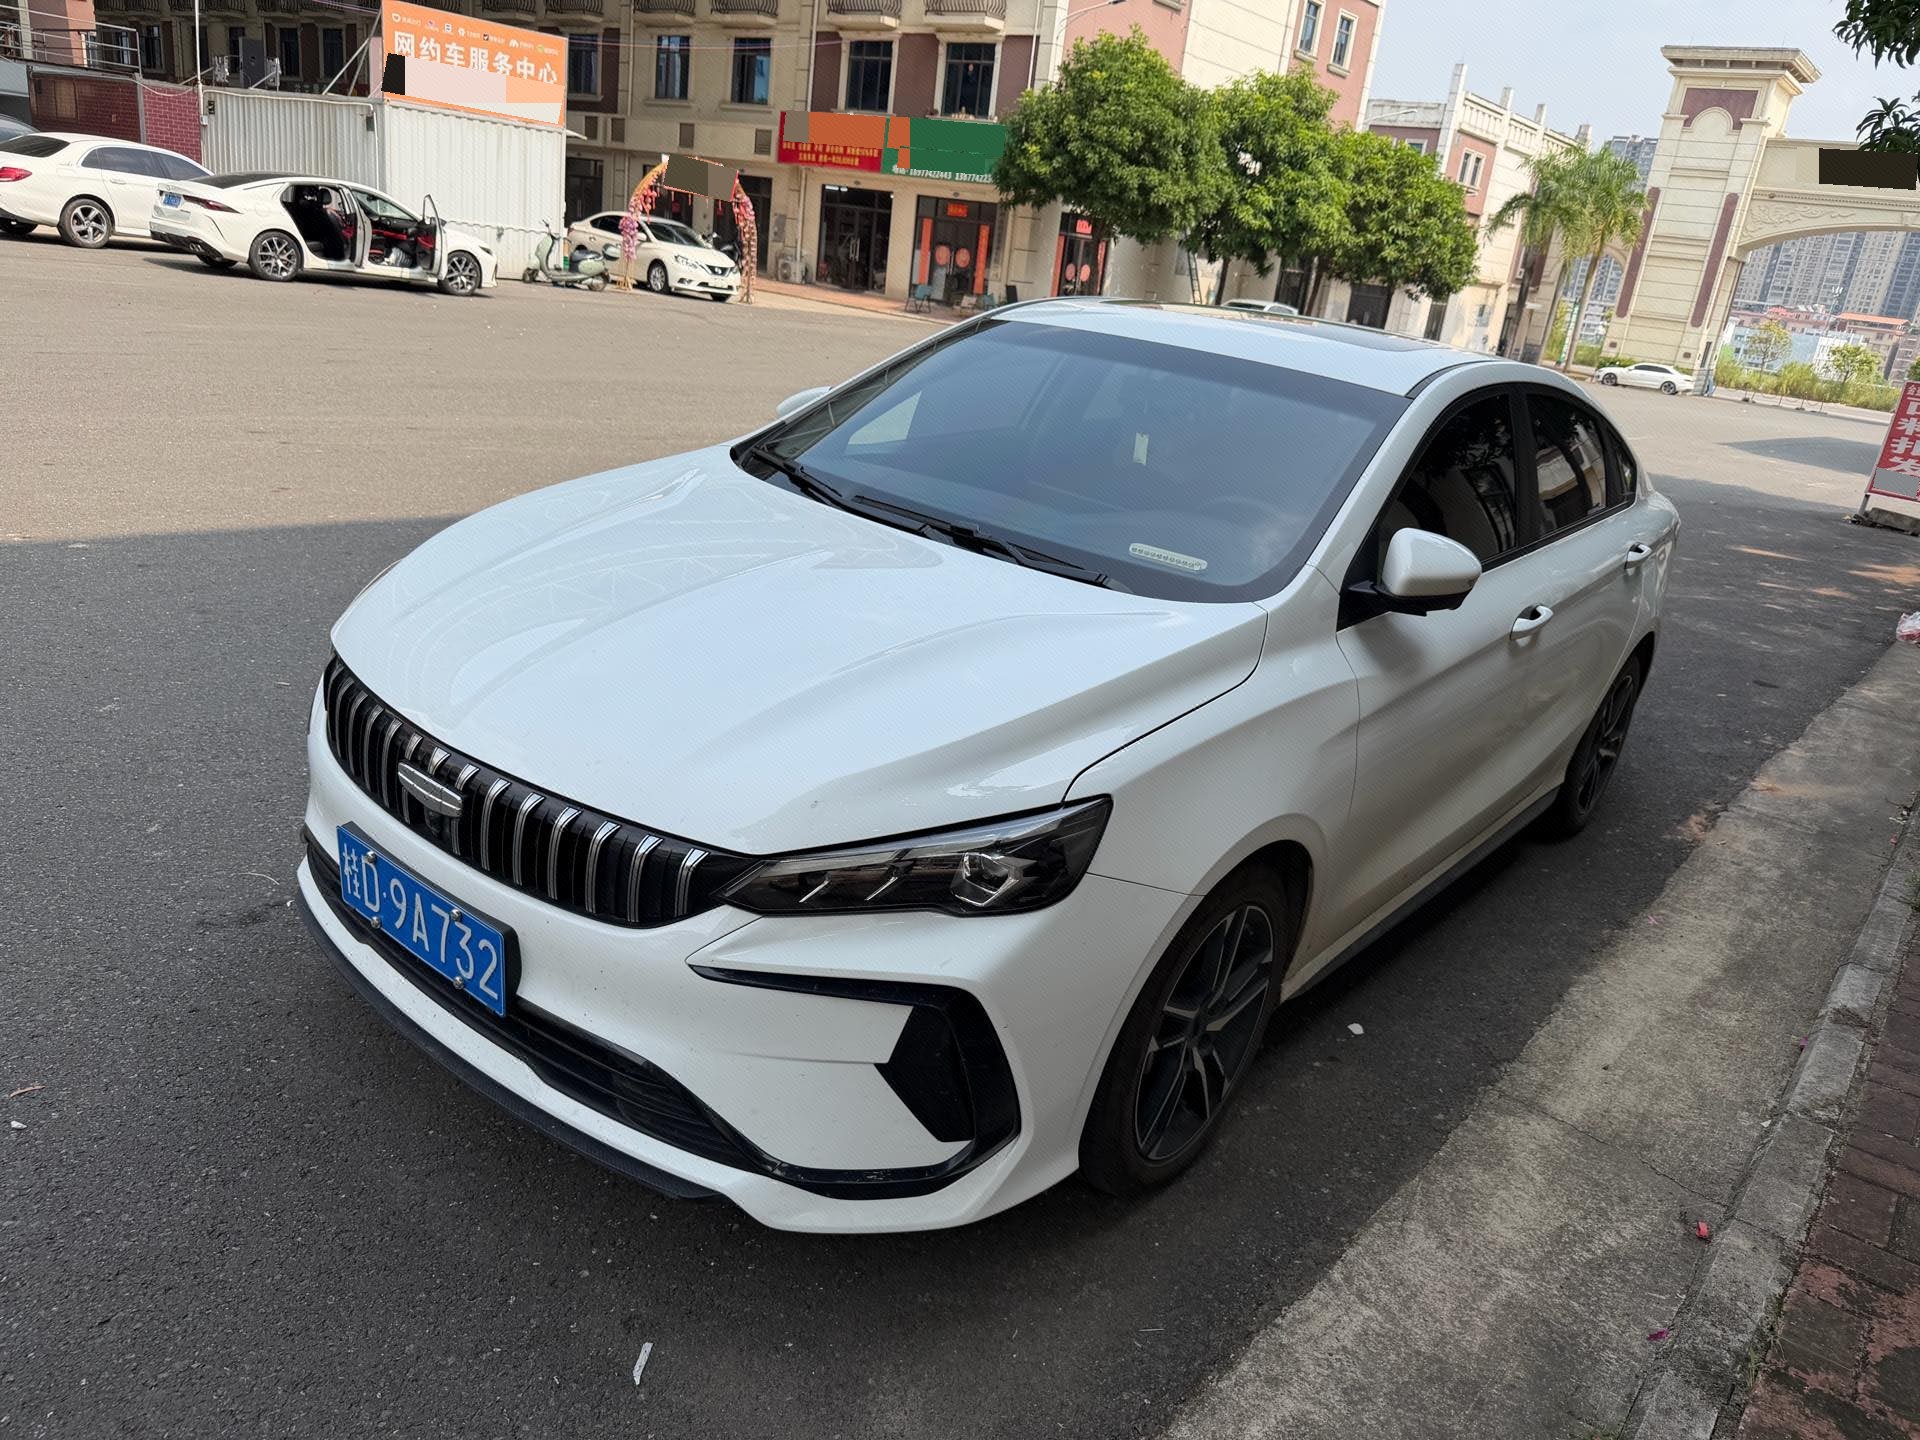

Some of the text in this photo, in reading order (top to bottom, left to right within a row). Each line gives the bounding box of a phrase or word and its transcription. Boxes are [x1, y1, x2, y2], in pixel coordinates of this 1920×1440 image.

[394, 31, 558, 84] 网约车服务中心
[342, 842, 499, 1000] 桂D·9A732
